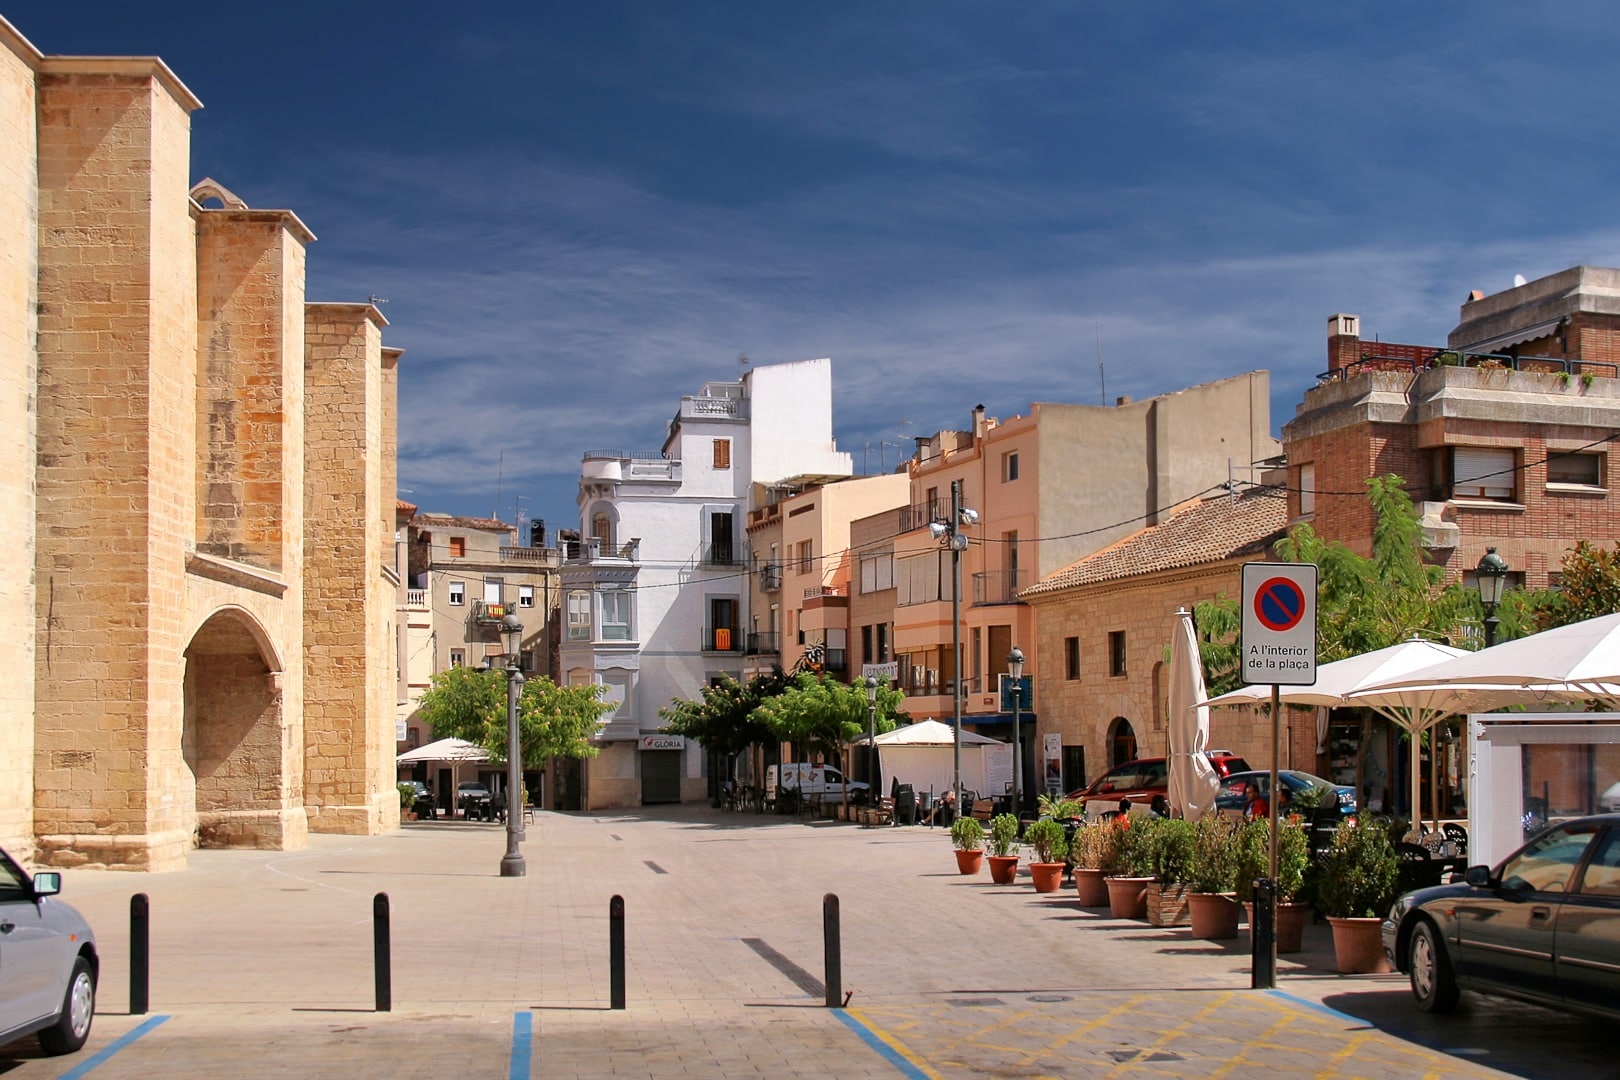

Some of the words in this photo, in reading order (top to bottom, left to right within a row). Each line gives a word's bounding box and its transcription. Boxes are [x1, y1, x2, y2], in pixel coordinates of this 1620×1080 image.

[1250, 645, 1258, 654] A
[1261, 645, 1308, 655] l'interior
[1248, 658, 1262, 668] de
[1266, 658, 1276, 668] la
[1279, 659, 1309, 670] plaça
